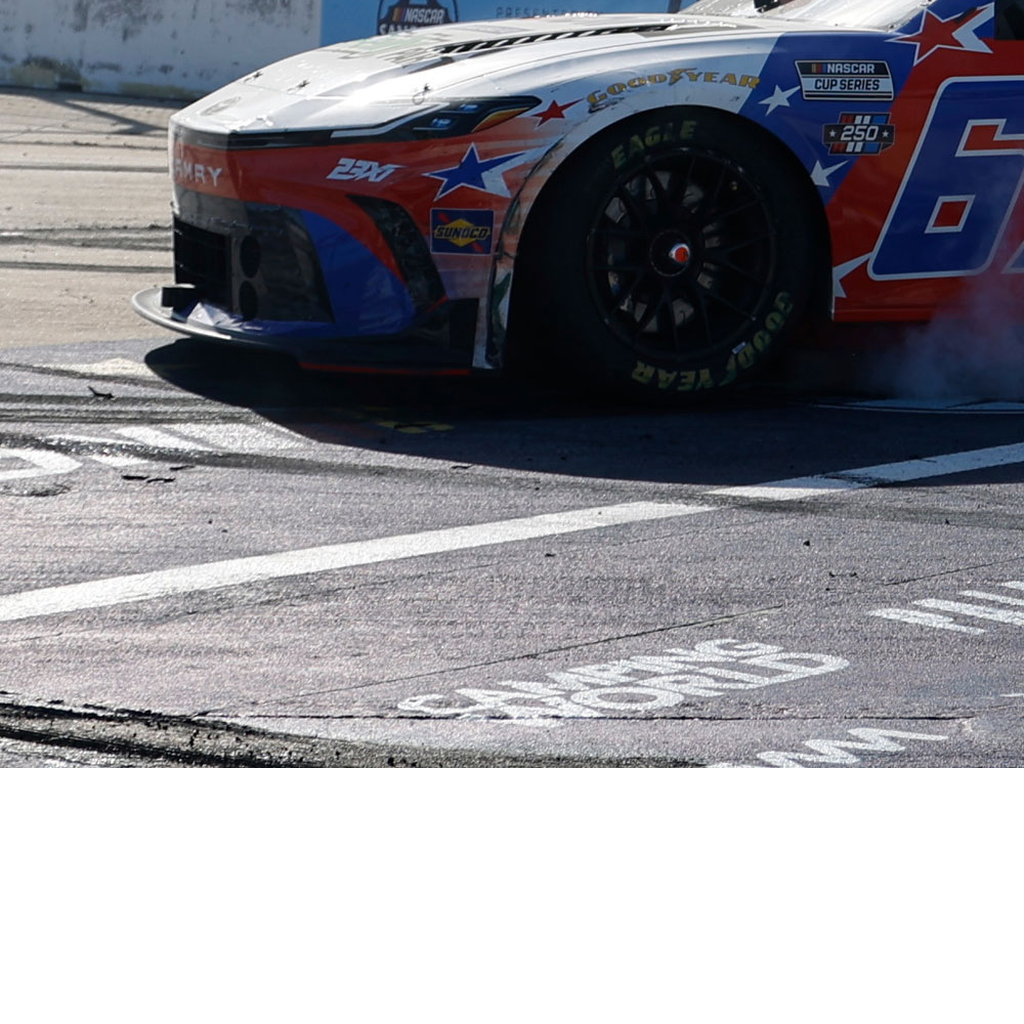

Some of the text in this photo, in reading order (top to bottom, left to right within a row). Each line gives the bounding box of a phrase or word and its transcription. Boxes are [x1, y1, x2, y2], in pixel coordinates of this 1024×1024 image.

[404, 7, 445, 24] NASCAR
[827, 63, 875, 74] NASCAR
[586, 67, 760, 110] GOODYEAR
[814, 78, 881, 91] CUP SERIES
[610, 119, 697, 169] EAGLE
[840, 125, 879, 141] 250
[173, 158, 222, 187] AMRY
[326, 157, 406, 183] 23XI
[434, 225, 491, 240] SUNOCO
[396, 639, 784, 715] CAMPING
[458, 653, 851, 727] WORLD
